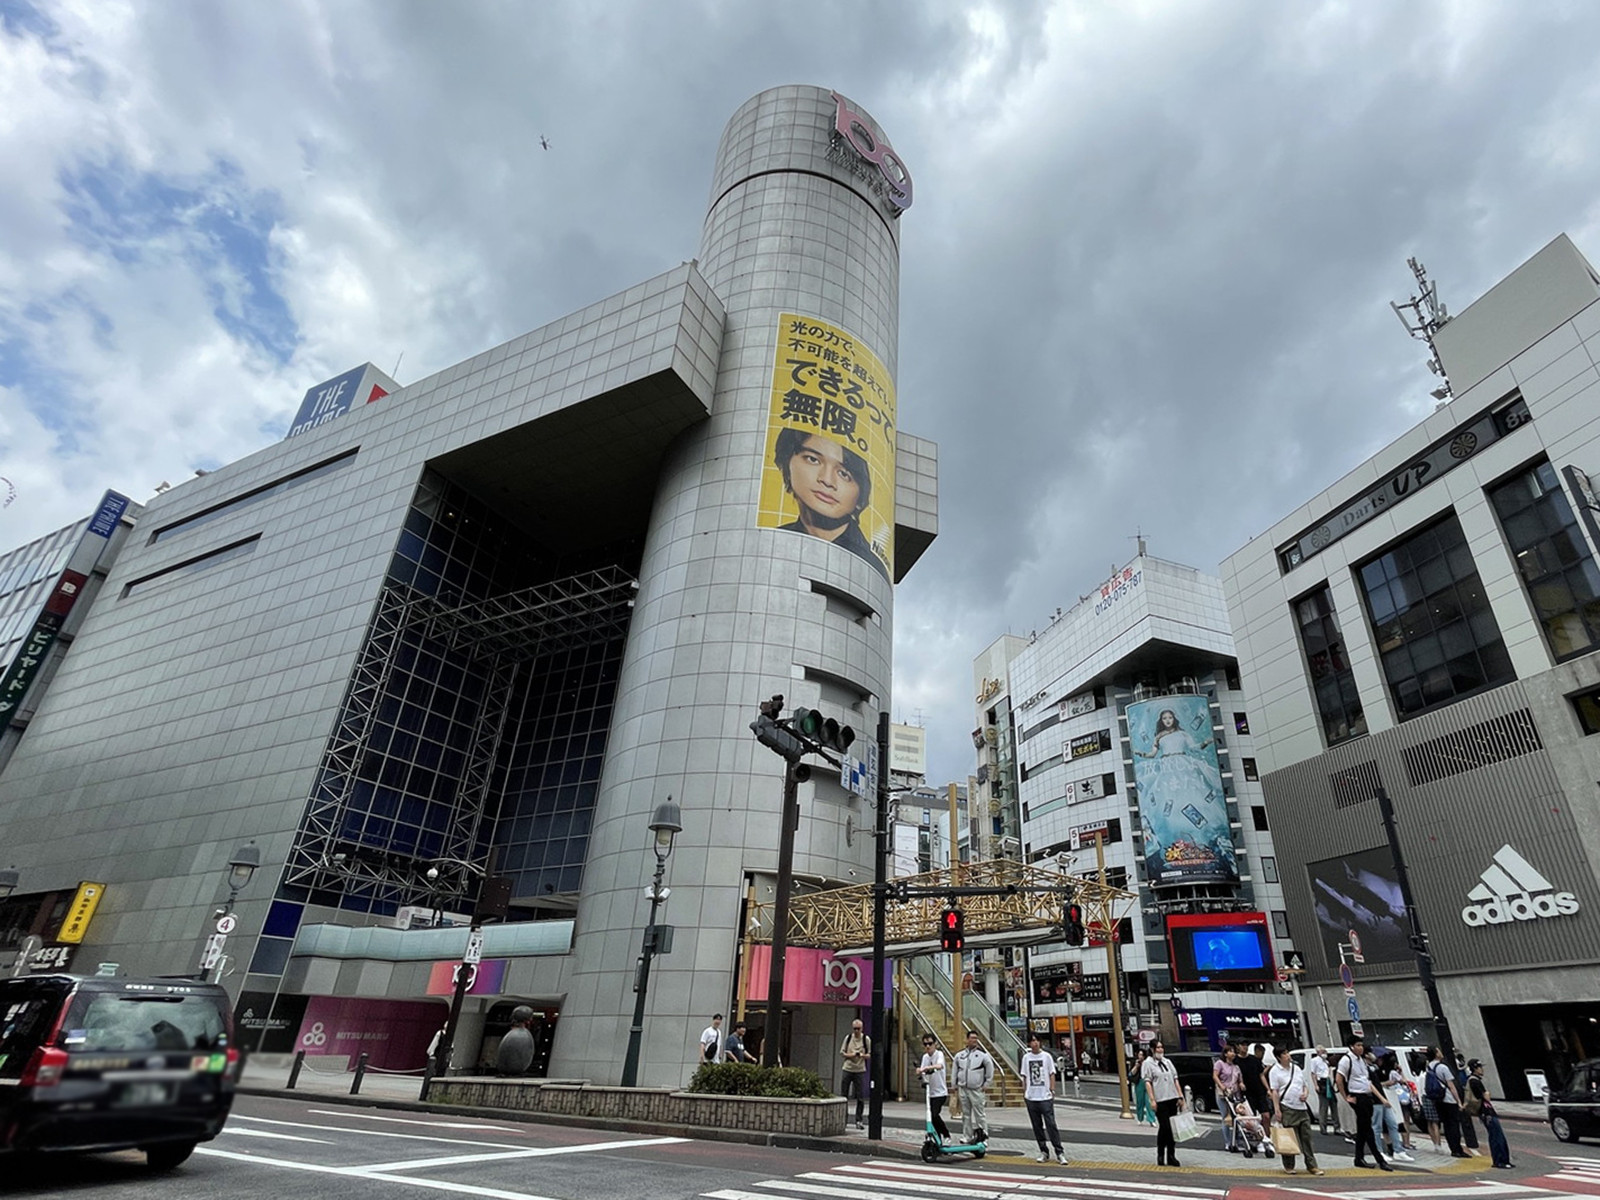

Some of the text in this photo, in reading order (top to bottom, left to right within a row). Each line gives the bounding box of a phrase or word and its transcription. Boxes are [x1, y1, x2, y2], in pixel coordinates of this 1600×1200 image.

[829, 89, 914, 210] 109
[789, 320, 857, 357] 光の力で、
[310, 380, 348, 418] THE
[787, 337, 895, 422] 不可能を超えてい
[780, 389, 869, 453] 無限。
[786, 358, 895, 453] できるって、
[1505, 406, 1532, 430] 8F
[1343, 461, 1432, 527] Darts UP
[92, 509, 117, 535] PRIME
[1094, 571, 1142, 616] 0120-075-787
[1099, 566, 1134, 600] 貸広告
[220, 919, 230, 931] 4
[1462, 891, 1580, 928] adidas
[822, 959, 862, 1001] 109
